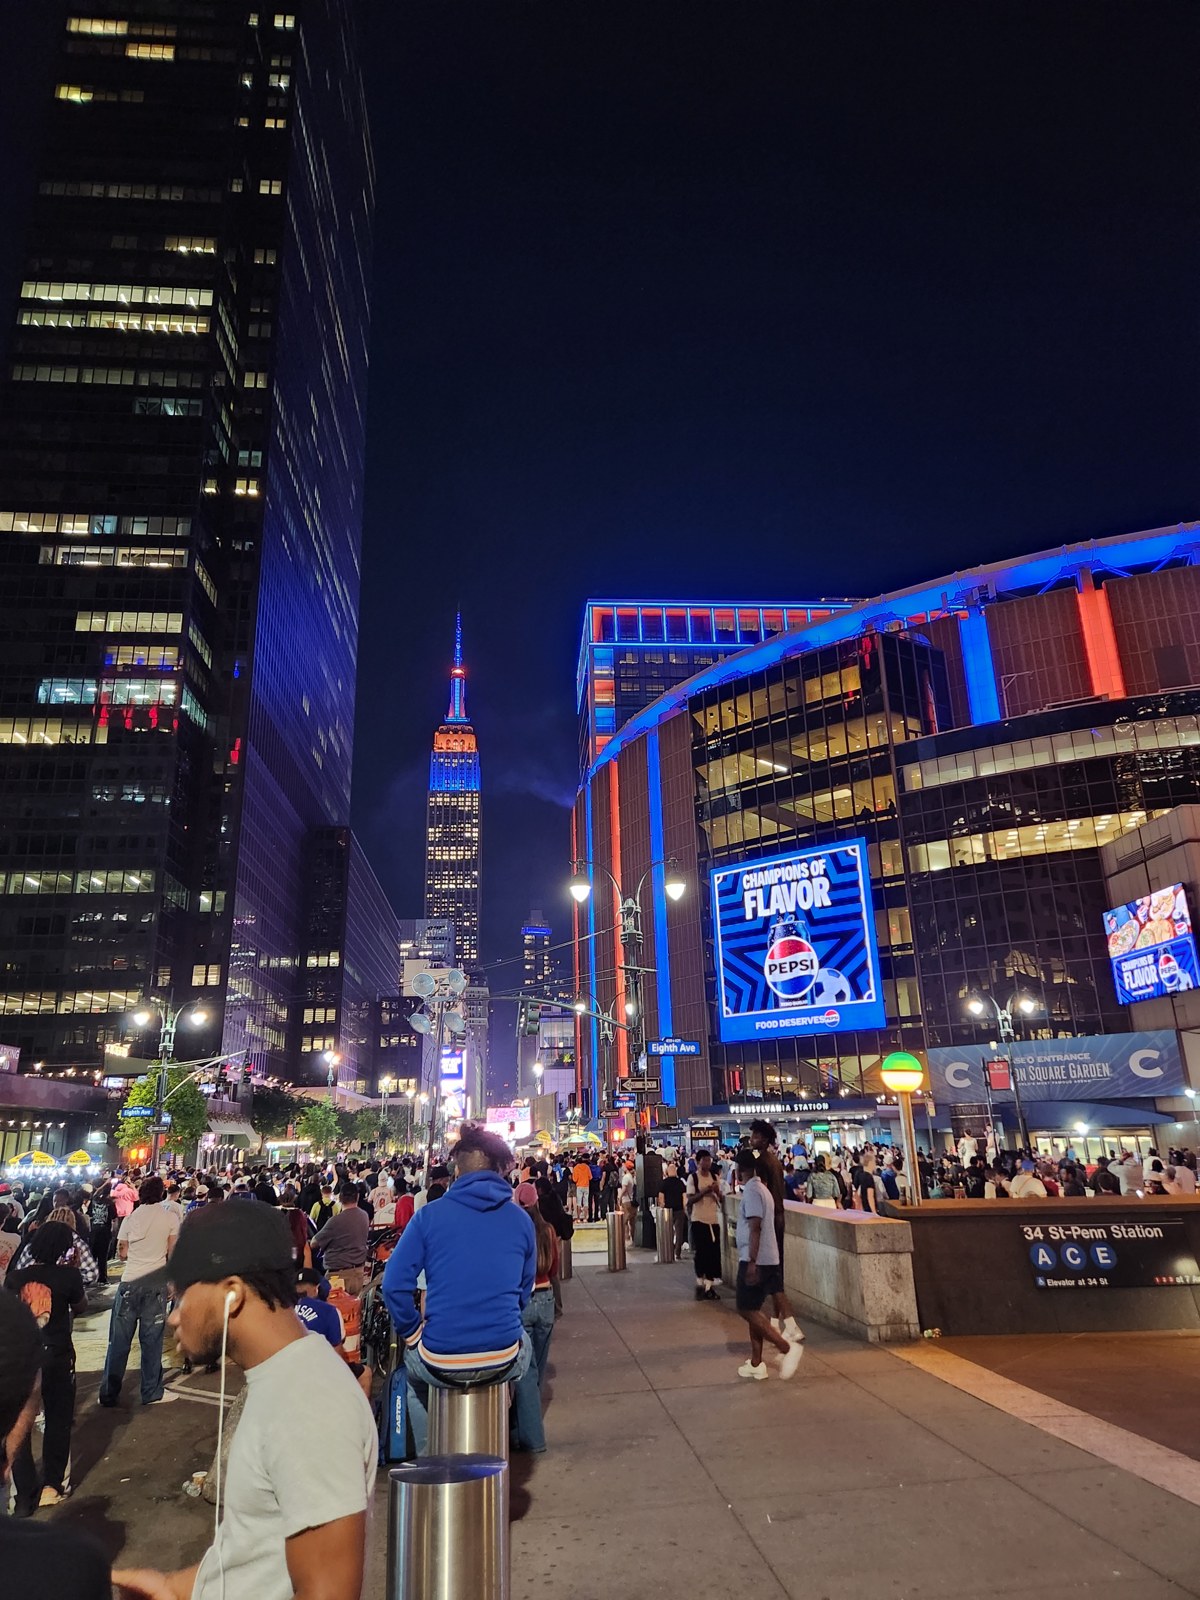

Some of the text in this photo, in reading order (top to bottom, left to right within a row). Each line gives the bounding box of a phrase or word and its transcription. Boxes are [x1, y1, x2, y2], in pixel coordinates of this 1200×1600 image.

[743, 858, 826, 890] CHAMPIONS OF
[743, 876, 832, 920] FLAVOR
[768, 958, 815, 976] PEPSI
[1160, 964, 1177, 974] PEPSI
[1123, 965, 1159, 991] FLAVOR
[755, 1020, 779, 1030] FOOD
[779, 1015, 825, 1028] DESERVES
[651, 1042, 696, 1055] Eighth Ave
[1036, 1052, 1091, 1063] ENTRANCE
[1128, 1049, 1164, 1079] C
[944, 1061, 972, 1089] C
[1028, 1065, 1067, 1082] SQUARE
[1068, 1062, 1110, 1079] GARDEN
[124, 1109, 141, 1117] Eighth
[729, 1103, 829, 1114] PENNSYLVANIA STATION
[1023, 1224, 1164, 1240] 34 St-Penn Station
[1038, 1246, 1112, 1265] A C E
[1046, 1279, 1076, 1287] Elevator
[1087, 1278, 1097, 1286] 34
[1184, 1275, 1190, 1283] 7
